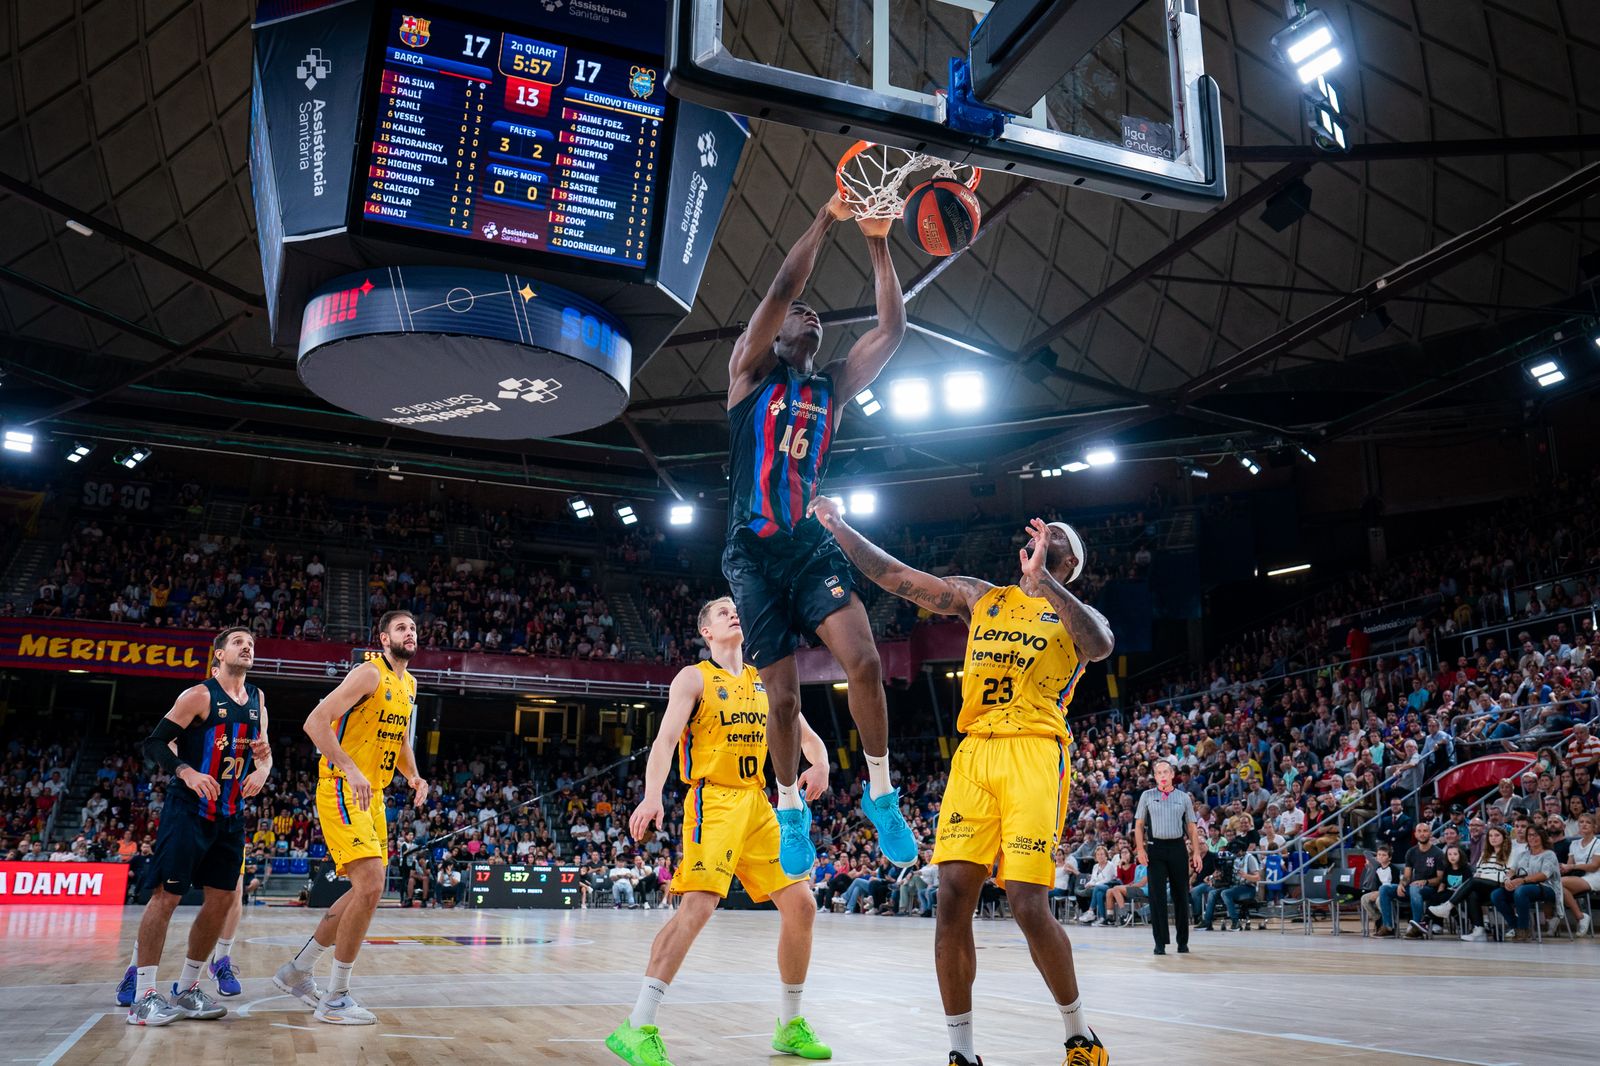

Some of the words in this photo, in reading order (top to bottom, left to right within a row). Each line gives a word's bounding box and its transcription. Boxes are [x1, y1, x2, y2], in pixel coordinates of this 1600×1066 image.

[462, 34, 490, 58] 17
[511, 40, 524, 51] 2n
[525, 44, 558, 58] QUART
[394, 52, 424, 64] BARÇA
[513, 54, 552, 76] 5:57
[574, 60, 602, 84] 17
[399, 76, 410, 84] DA
[412, 78, 435, 90] SILVA
[397, 87, 422, 99] PAULÍ
[516, 86, 540, 107] 13
[396, 99, 420, 111] ŞANLI
[584, 93, 621, 107] LEONOVO
[623, 101, 660, 116] TENERIFE
[394, 111, 424, 124] VESELY
[476, 116, 481, 124] 3
[578, 114, 602, 124] JAIME
[603, 119, 624, 130] FDEZ.
[299, 102, 312, 171] Sanitària
[382, 121, 391, 129] 10
[392, 124, 426, 136] KALINIC
[510, 126, 536, 137] FALTES
[577, 125, 604, 137] SERGIO
[606, 131, 632, 143] RGUEZ.
[1124, 126, 1146, 140] liga
[313, 99, 326, 197] Assistència
[390, 135, 444, 152] SATORANSKY
[500, 138, 510, 152] 3
[532, 144, 542, 158] 2
[575, 136, 614, 150] FITIPALDO
[1125, 139, 1171, 158] endesa
[378, 146, 388, 154] 20
[388, 147, 448, 166] LAPROVITTOLA
[574, 148, 608, 160] HUERTAS
[376, 157, 386, 165] 22
[387, 158, 422, 172] HIGGINS
[572, 159, 595, 170] SALIN
[386, 170, 435, 186] JOKUBAITIS
[493, 166, 518, 178] TEMPS
[520, 172, 542, 182] MORT
[571, 171, 600, 183] DIAGNE
[372, 181, 384, 190] 42
[384, 182, 420, 196] CAICEDO
[494, 180, 504, 194] 0
[528, 186, 538, 200] 0
[569, 182, 598, 194] SASTRE
[371, 192, 382, 201] 45
[382, 194, 412, 208] VILLAR
[681, 170, 700, 232] Sanitària
[369, 204, 380, 214] 46
[381, 206, 408, 218] NNAJI
[464, 209, 469, 217] 0
[566, 205, 614, 220] ABROMAITIS
[555, 214, 564, 222] 23
[565, 216, 586, 226] COOK
[682, 176, 708, 265] Assistència
[564, 228, 584, 238] CRUZ
[552, 238, 562, 246] 42
[562, 240, 616, 255] DOORNEKAMP
[779, 425, 809, 460] 46
[84, 481, 114, 506] SC
[120, 485, 151, 511] CC
[974, 625, 1048, 651] Lenovo
[18, 634, 200, 668] MERITXELL
[982, 677, 1014, 705] 23
[222, 756, 244, 780] 20
[380, 751, 396, 770] 33
[739, 756, 758, 778] 10
[1016, 836, 1032, 844] islas
[476, 872, 490, 881] 17
[504, 872, 529, 882] 5:57
[561, 874, 574, 882] 17
[1266, 868, 1278, 881] 21
[13, 872, 103, 895] DAMM
[477, 896, 483, 904] 3
